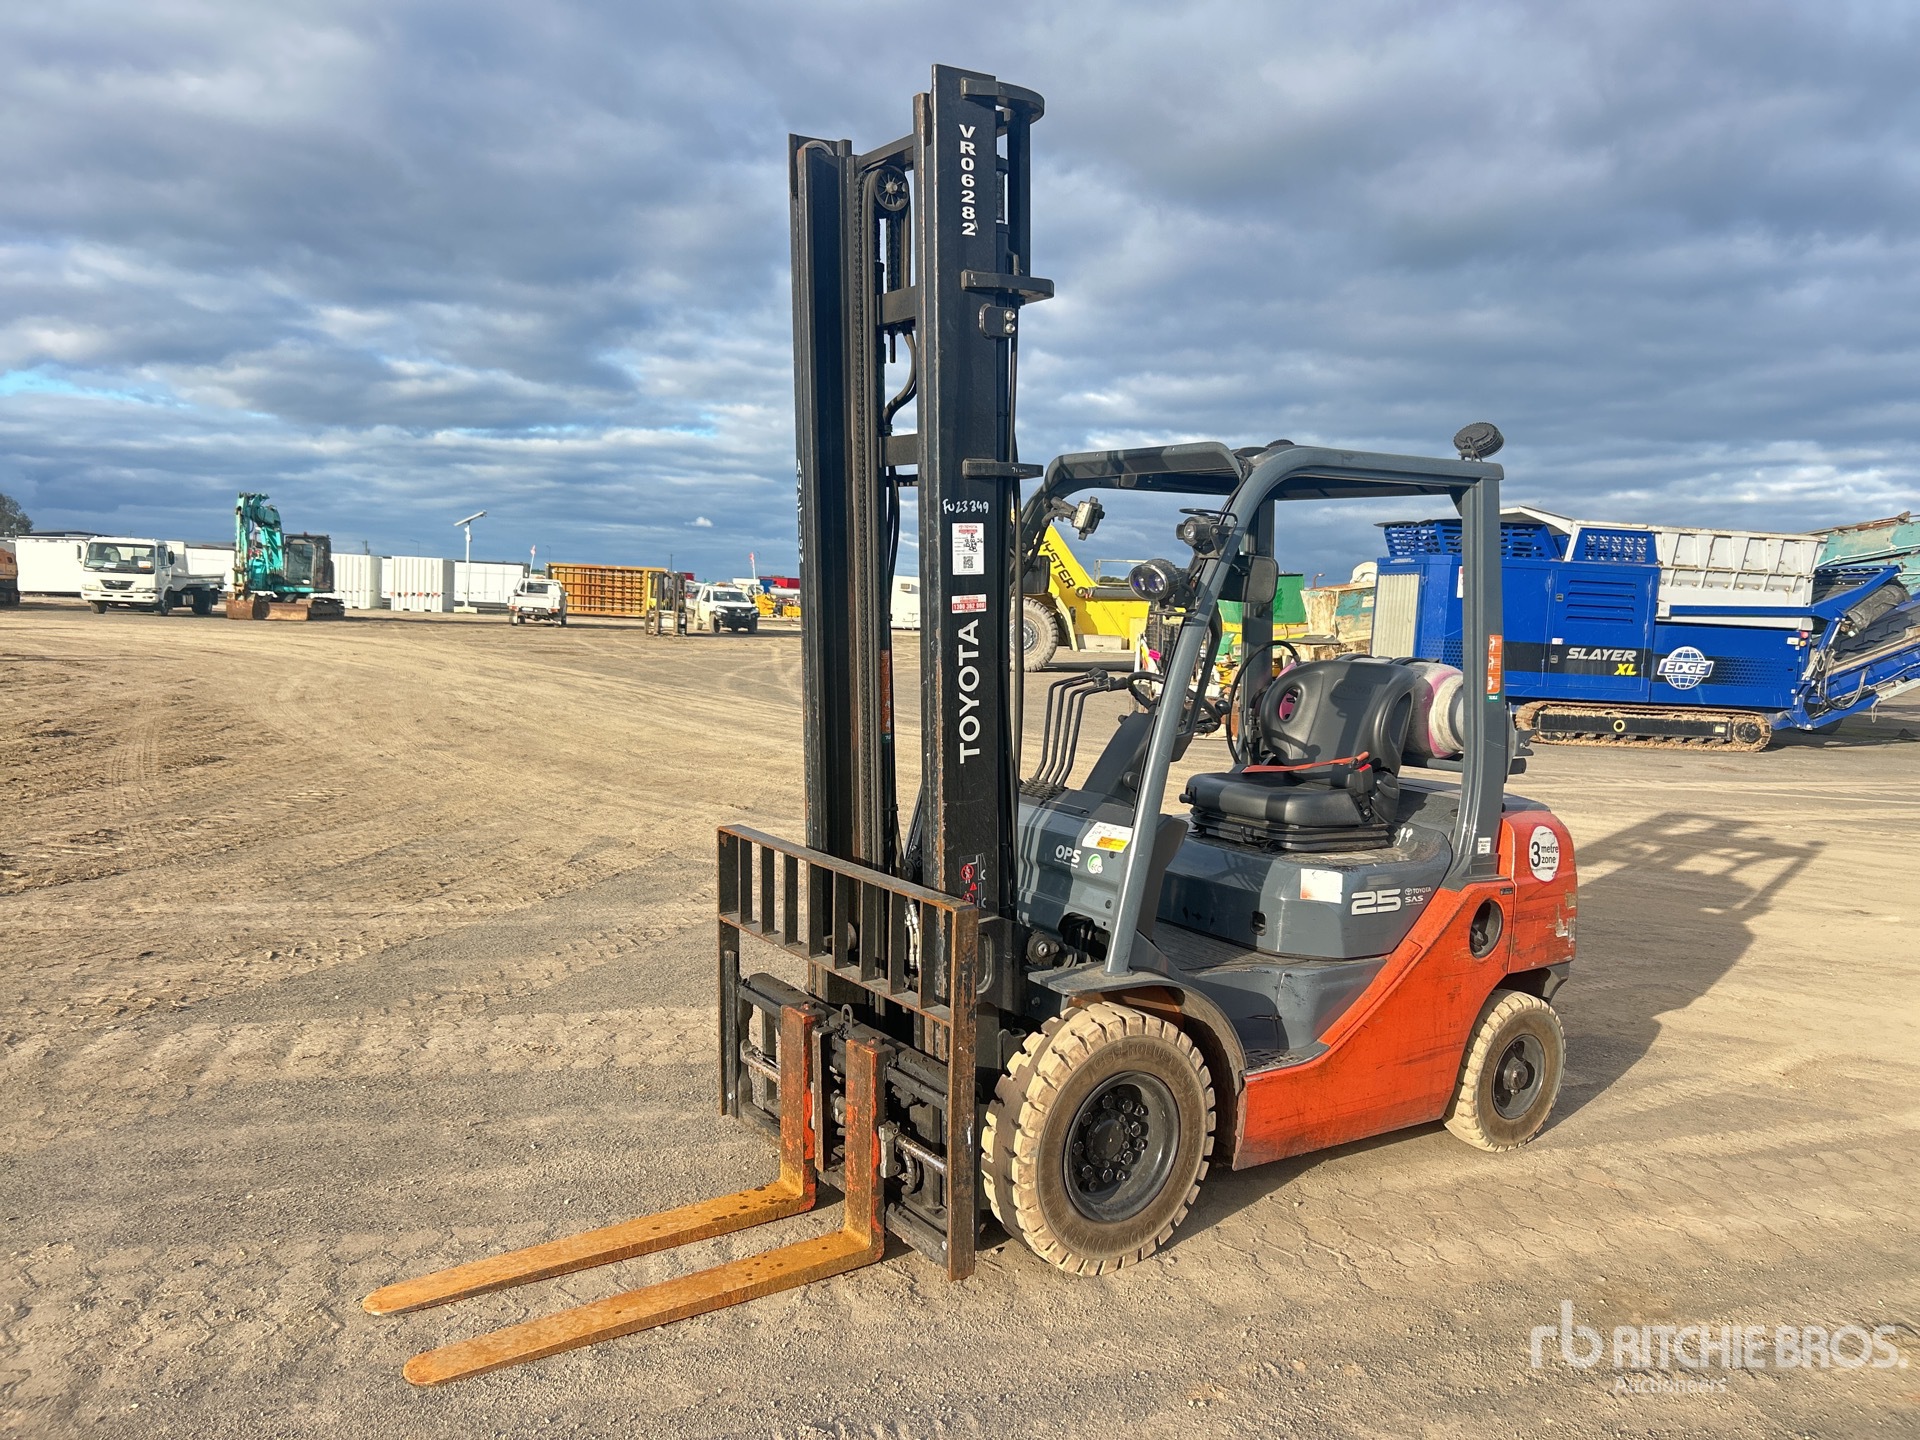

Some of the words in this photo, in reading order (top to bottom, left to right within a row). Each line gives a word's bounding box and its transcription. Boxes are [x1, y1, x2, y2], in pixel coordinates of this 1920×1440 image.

[959, 124, 977, 236] VR06282
[1566, 647, 1637, 662] SLAYER
[1614, 663, 1637, 676] XL
[1664, 661, 1707, 674] EDGE
[958, 619, 981, 764] TOYOTA
[1055, 844, 1082, 864] OPS
[1531, 841, 1541, 867] 3
[1541, 844, 1559, 854] metre
[1412, 886, 1432, 894] TOYOTA
[1351, 889, 1402, 916] 25
[1404, 895, 1424, 903] SAS
